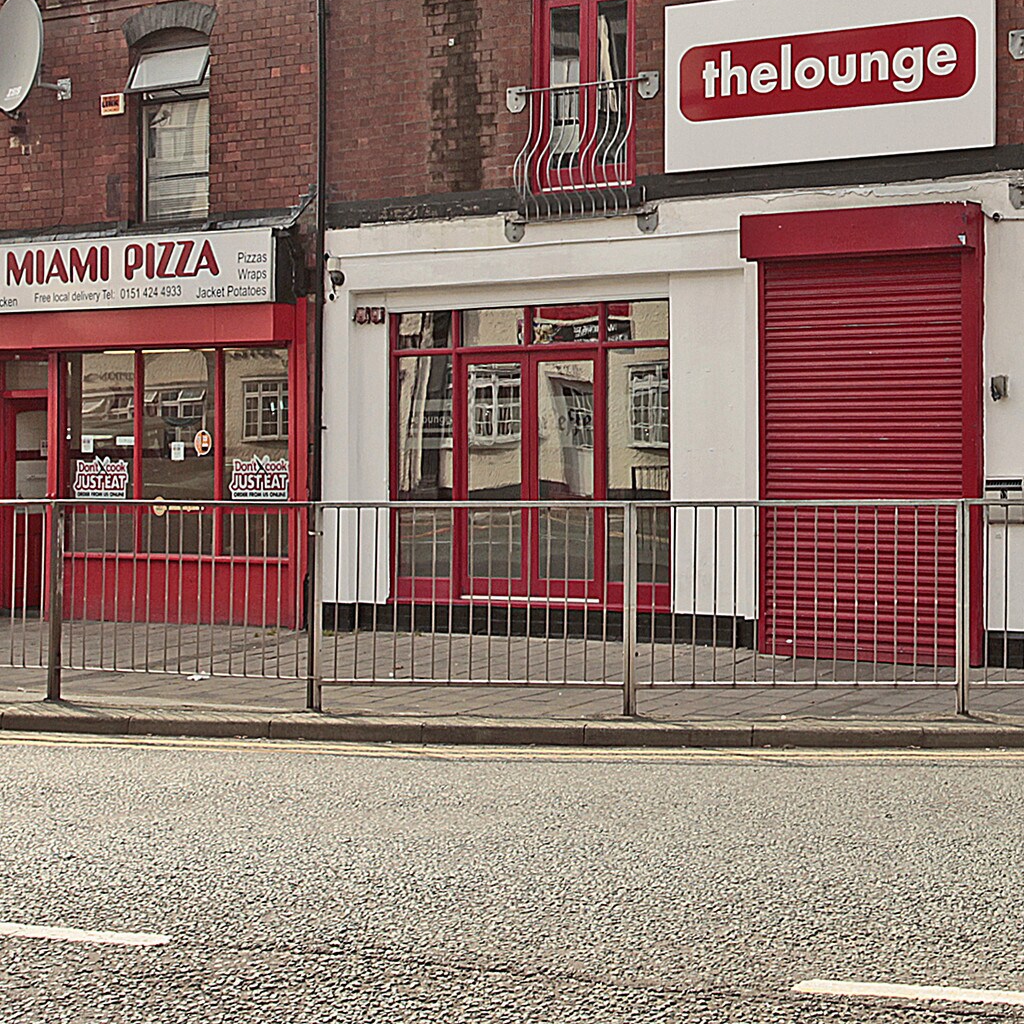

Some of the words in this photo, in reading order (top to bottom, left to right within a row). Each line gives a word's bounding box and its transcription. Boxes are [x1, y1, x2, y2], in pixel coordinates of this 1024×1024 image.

[702, 42, 958, 99] thelounge
[6, 245, 110, 286] MIAMI
[124, 239, 220, 281] PIZZA
[237, 251, 268, 264] Pizzas
[237, 268, 268, 283] Wraps
[34, 292, 52, 303] Free
[53, 291, 70, 302] local
[71, 289, 101, 303] delivery
[102, 288, 116, 300] Tel:
[120, 288, 141, 300] 0151
[143, 287, 159, 299] 424
[160, 285, 182, 297] 4933
[196, 286, 226, 299] Jacket
[226, 284, 267, 298] Potatoes
[106, 461, 126, 472] cook
[265, 459, 288, 472] cook
[76, 474, 104, 489] JUST
[104, 474, 127, 490] EAT
[232, 473, 263, 489] JUST
[264, 473, 288, 489] EAT
